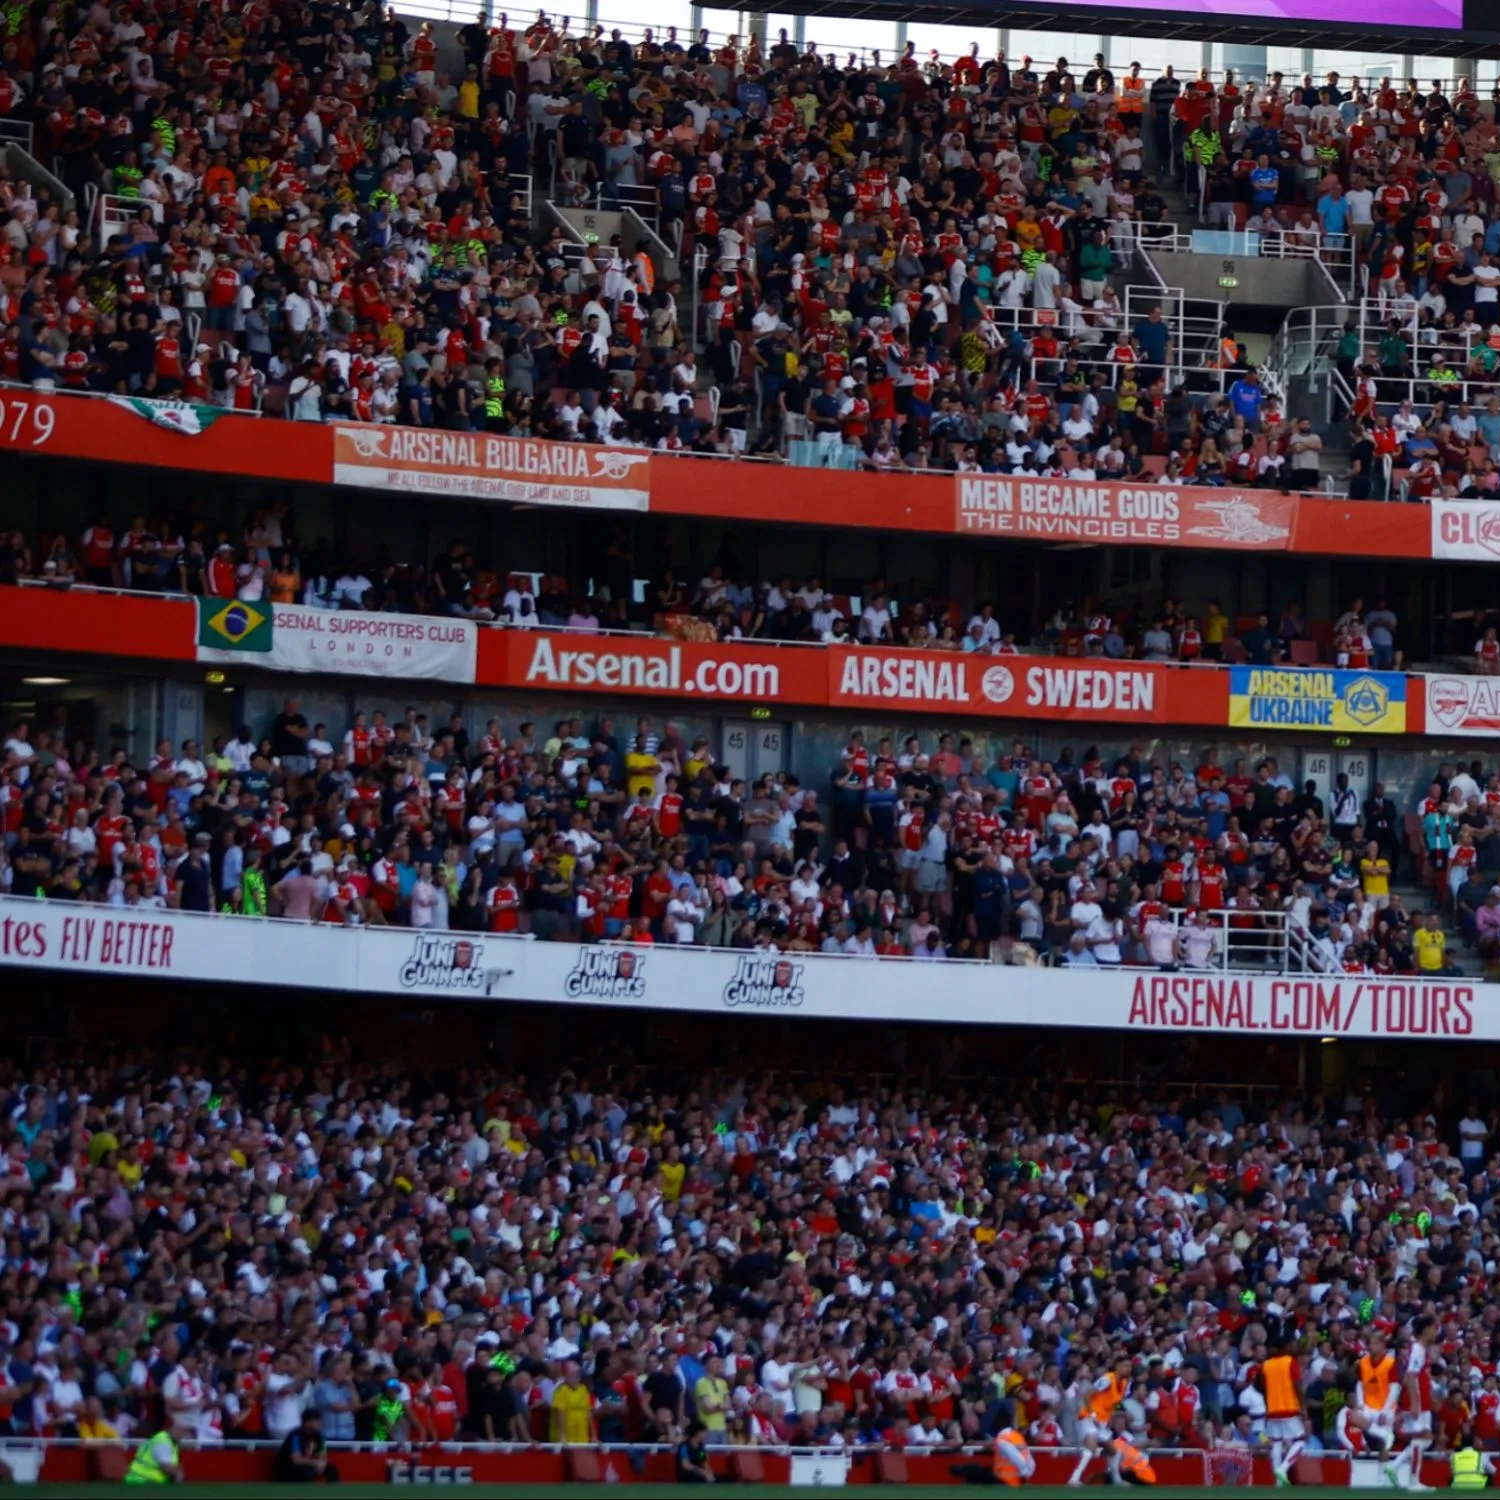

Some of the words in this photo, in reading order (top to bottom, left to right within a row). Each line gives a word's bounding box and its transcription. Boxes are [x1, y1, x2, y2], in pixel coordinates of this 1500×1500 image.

[1223, 260, 1235, 273] 96
[0, 397, 56, 445] 79
[388, 431, 480, 468] ARSENAL
[486, 438, 591, 477] BULGARIA
[401, 473, 416, 487] ALL
[418, 474, 450, 490] FOLLOW
[452, 477, 469, 492] THE
[471, 479, 505, 495] ARSENAL
[528, 483, 549, 499] LAND
[552, 486, 571, 500] AND
[573, 487, 591, 501] SEA
[961, 479, 1013, 511] MEN
[1020, 483, 1111, 519] BECAME
[1118, 489, 1180, 522] GODS
[961, 512, 1013, 531] THE
[1019, 515, 1180, 540] INVINCIBLES
[272, 613, 325, 633] RSENAL
[329, 617, 425, 640] SUPPORTERS
[428, 626, 466, 643] CLUB
[526, 638, 780, 696] Arsenal.com
[840, 656, 970, 702] ARSENAL
[1026, 667, 1154, 711] SWEDEN
[1248, 669, 1337, 699] ARSENAL
[1249, 697, 1334, 726] UKRAINE
[728, 731, 743, 749] 45
[762, 733, 778, 751] 45
[1309, 758, 1326, 774] 46
[1347, 760, 1364, 777] 46
[60, 917, 95, 961] FLY
[100, 920, 174, 968] BETTER
[1129, 976, 1474, 1035] ARSENAL.COM/TOURS
